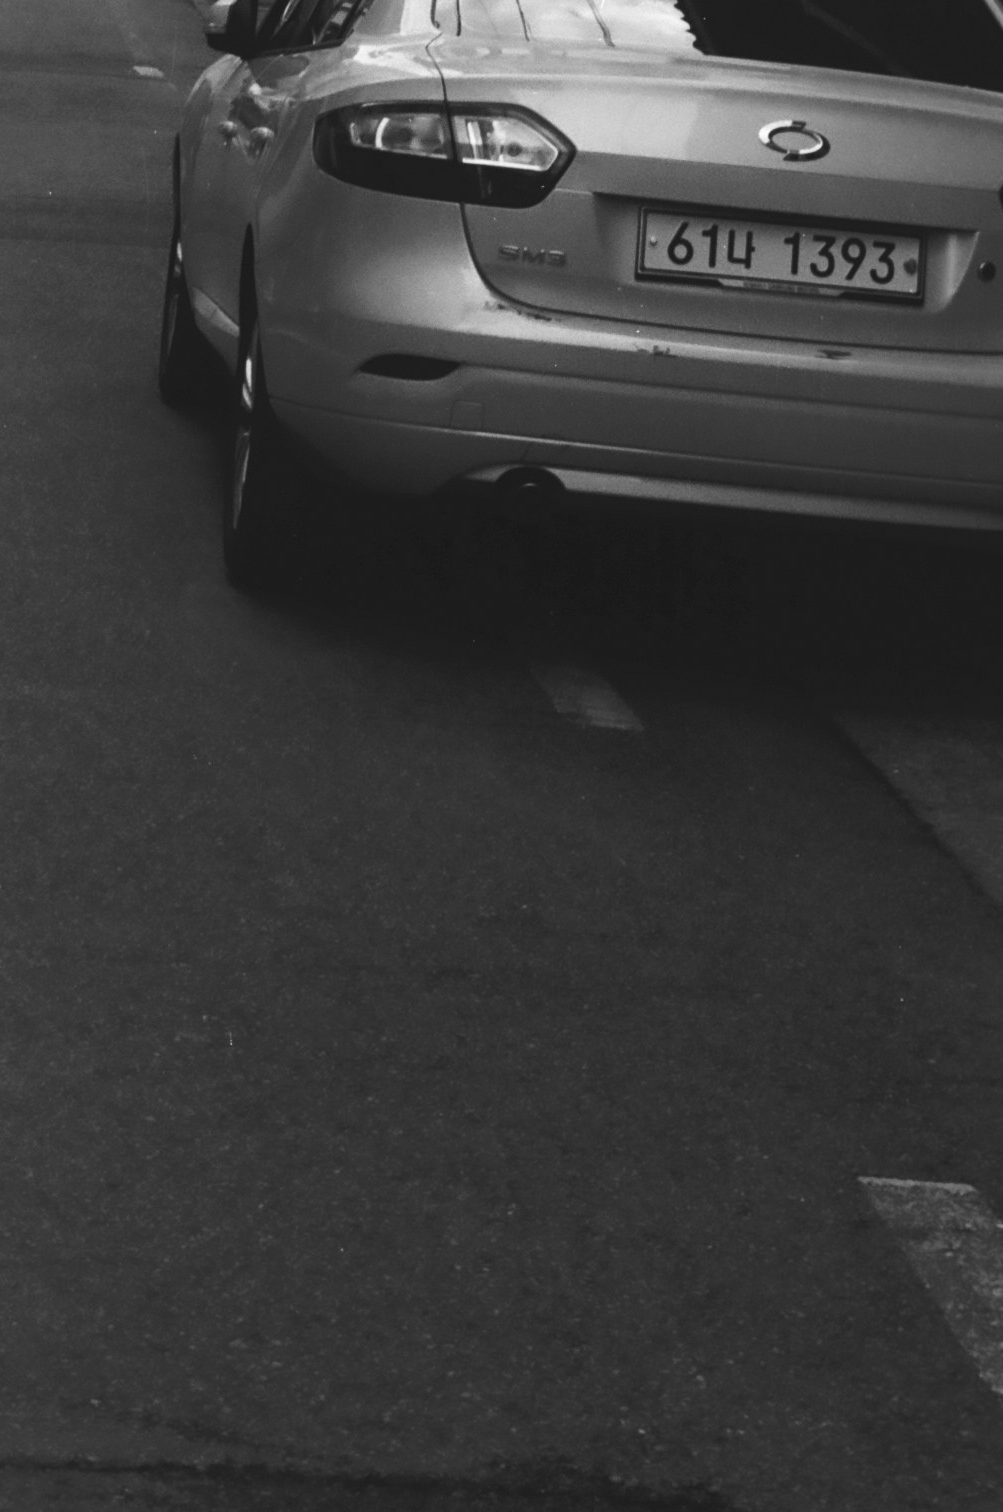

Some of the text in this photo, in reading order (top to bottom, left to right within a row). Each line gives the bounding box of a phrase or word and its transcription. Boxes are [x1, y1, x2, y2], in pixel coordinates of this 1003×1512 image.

[499, 245, 567, 267] SM3
[666, 221, 896, 284] 61나 1393
